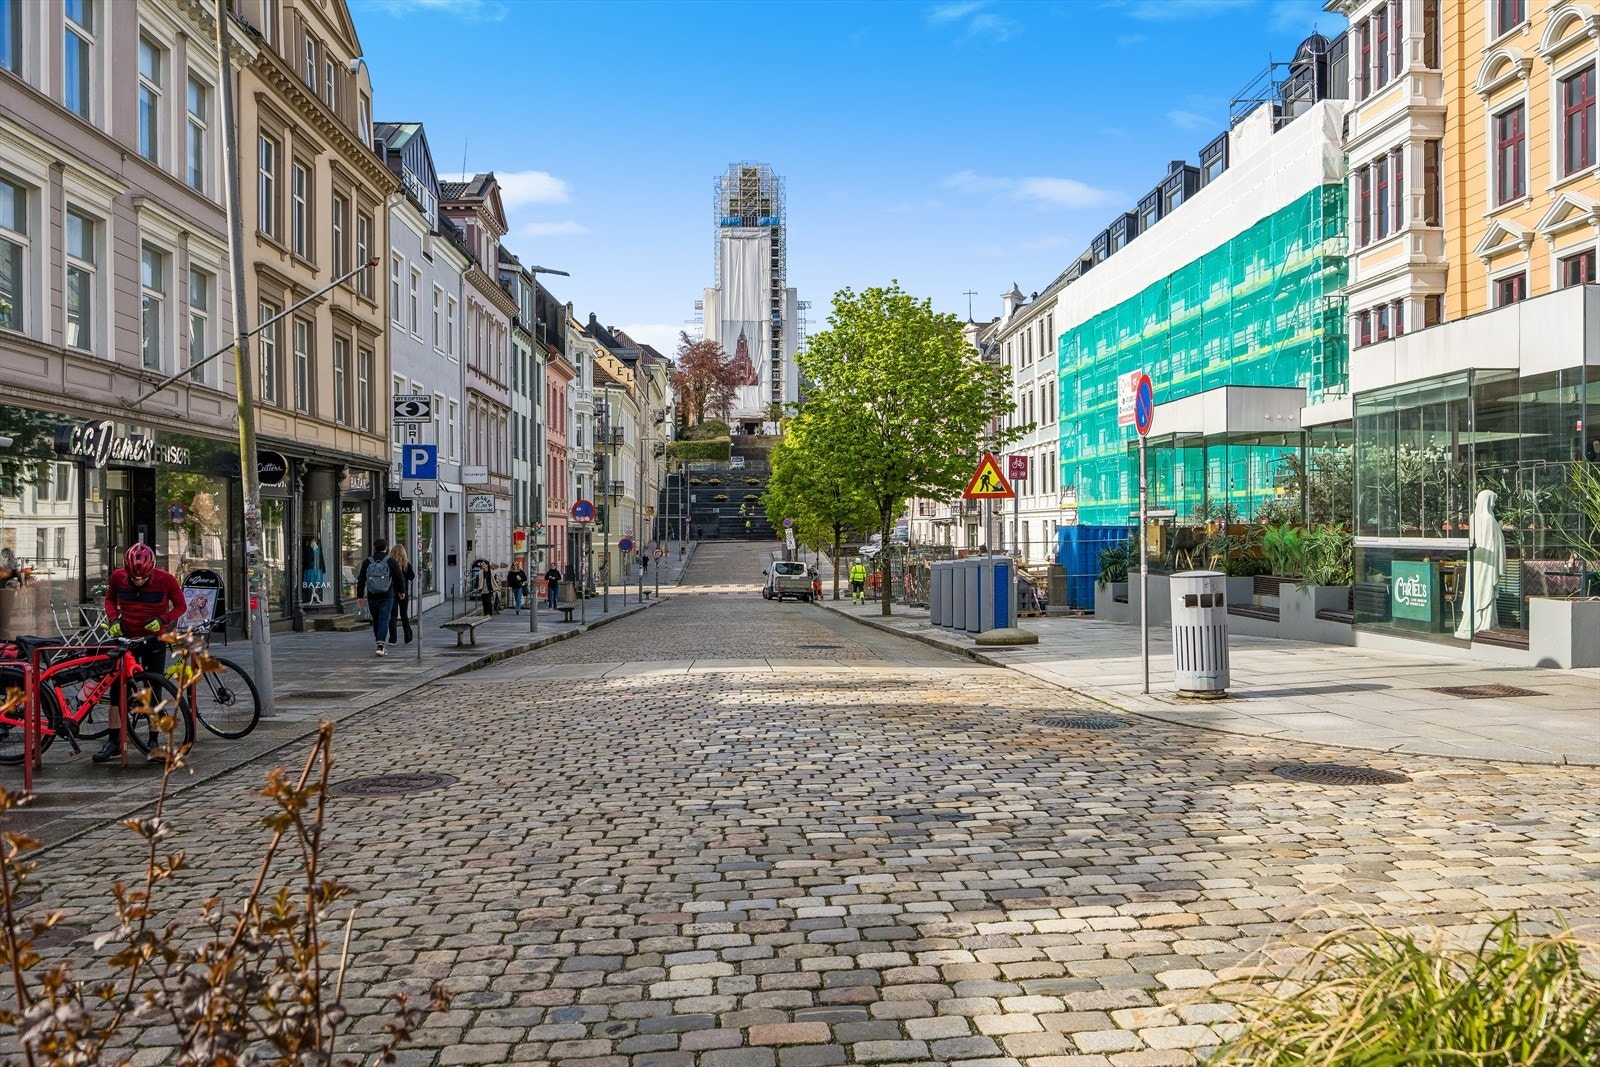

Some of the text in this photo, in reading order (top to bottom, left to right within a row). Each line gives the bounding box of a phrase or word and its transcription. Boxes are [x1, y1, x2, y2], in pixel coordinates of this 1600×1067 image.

[154, 443, 191, 466] FRISØR
[411, 449, 429, 475] P
[351, 477, 367, 489] BAZAR
[303, 581, 331, 589] BAZAR
